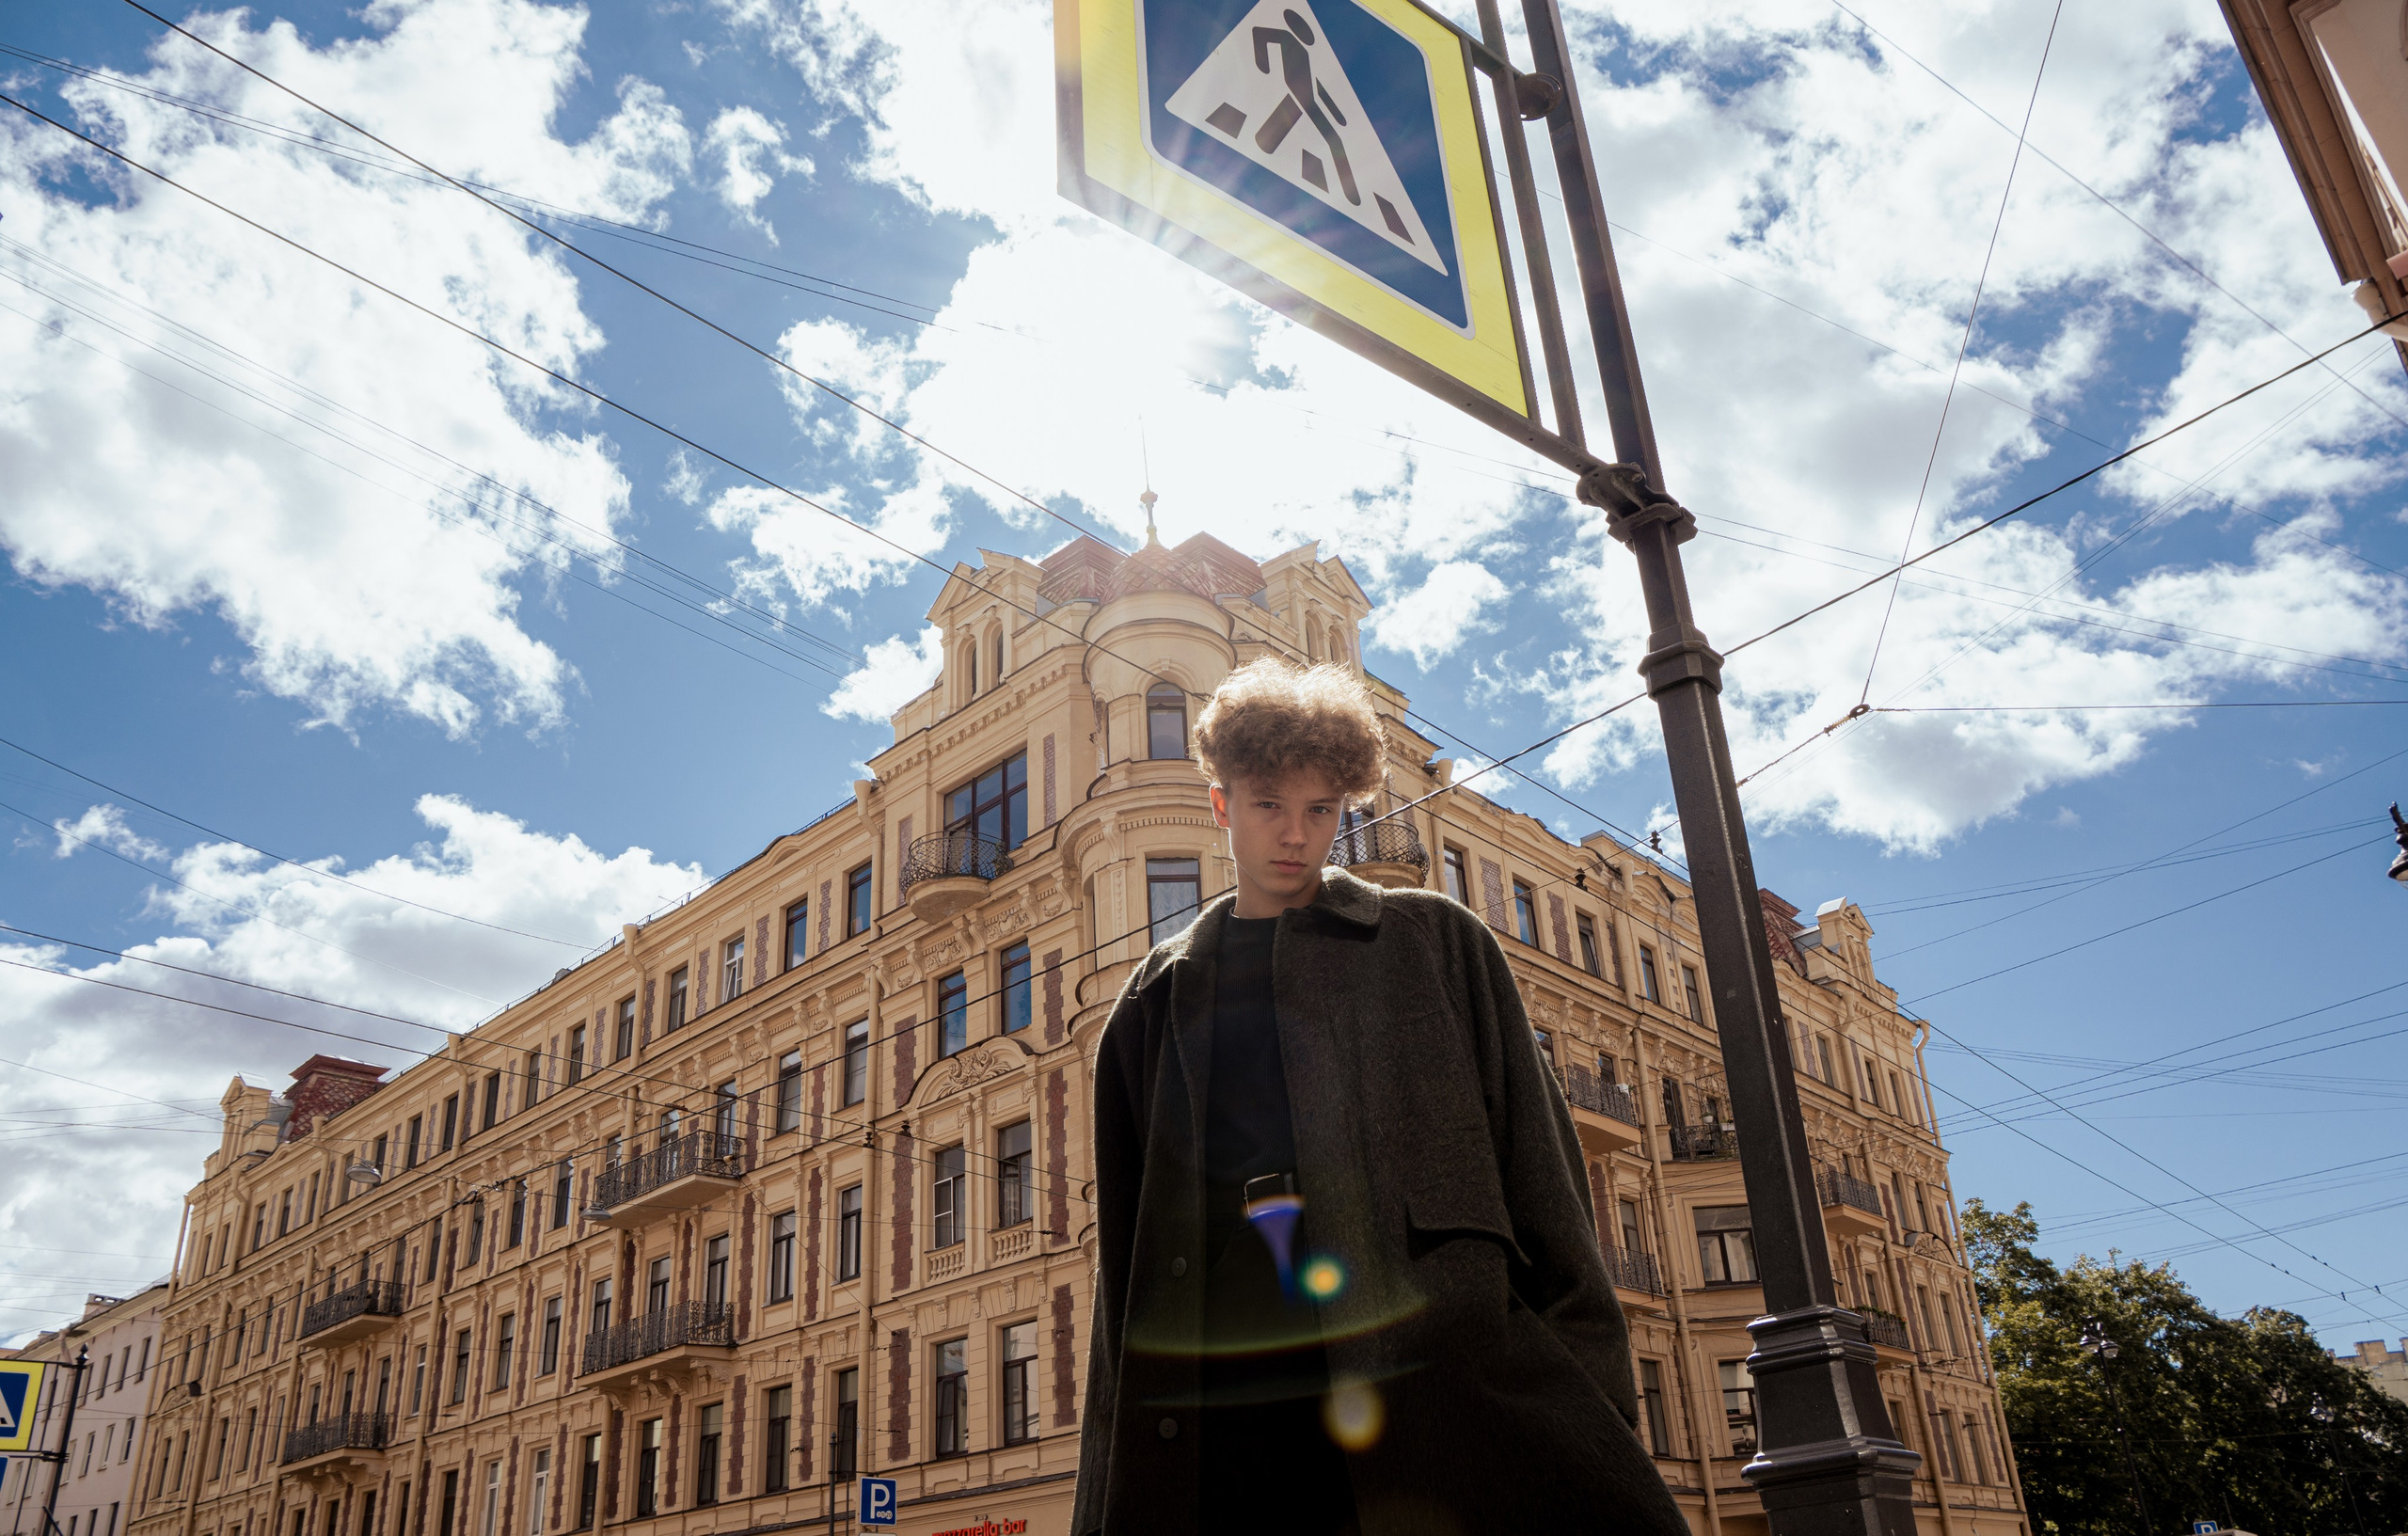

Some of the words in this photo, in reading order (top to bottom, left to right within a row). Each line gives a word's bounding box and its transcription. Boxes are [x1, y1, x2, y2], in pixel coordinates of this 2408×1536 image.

[870, 1483, 890, 1519] P
[932, 1521, 1000, 1536] zzarella
[1002, 1518, 1027, 1535] bar
